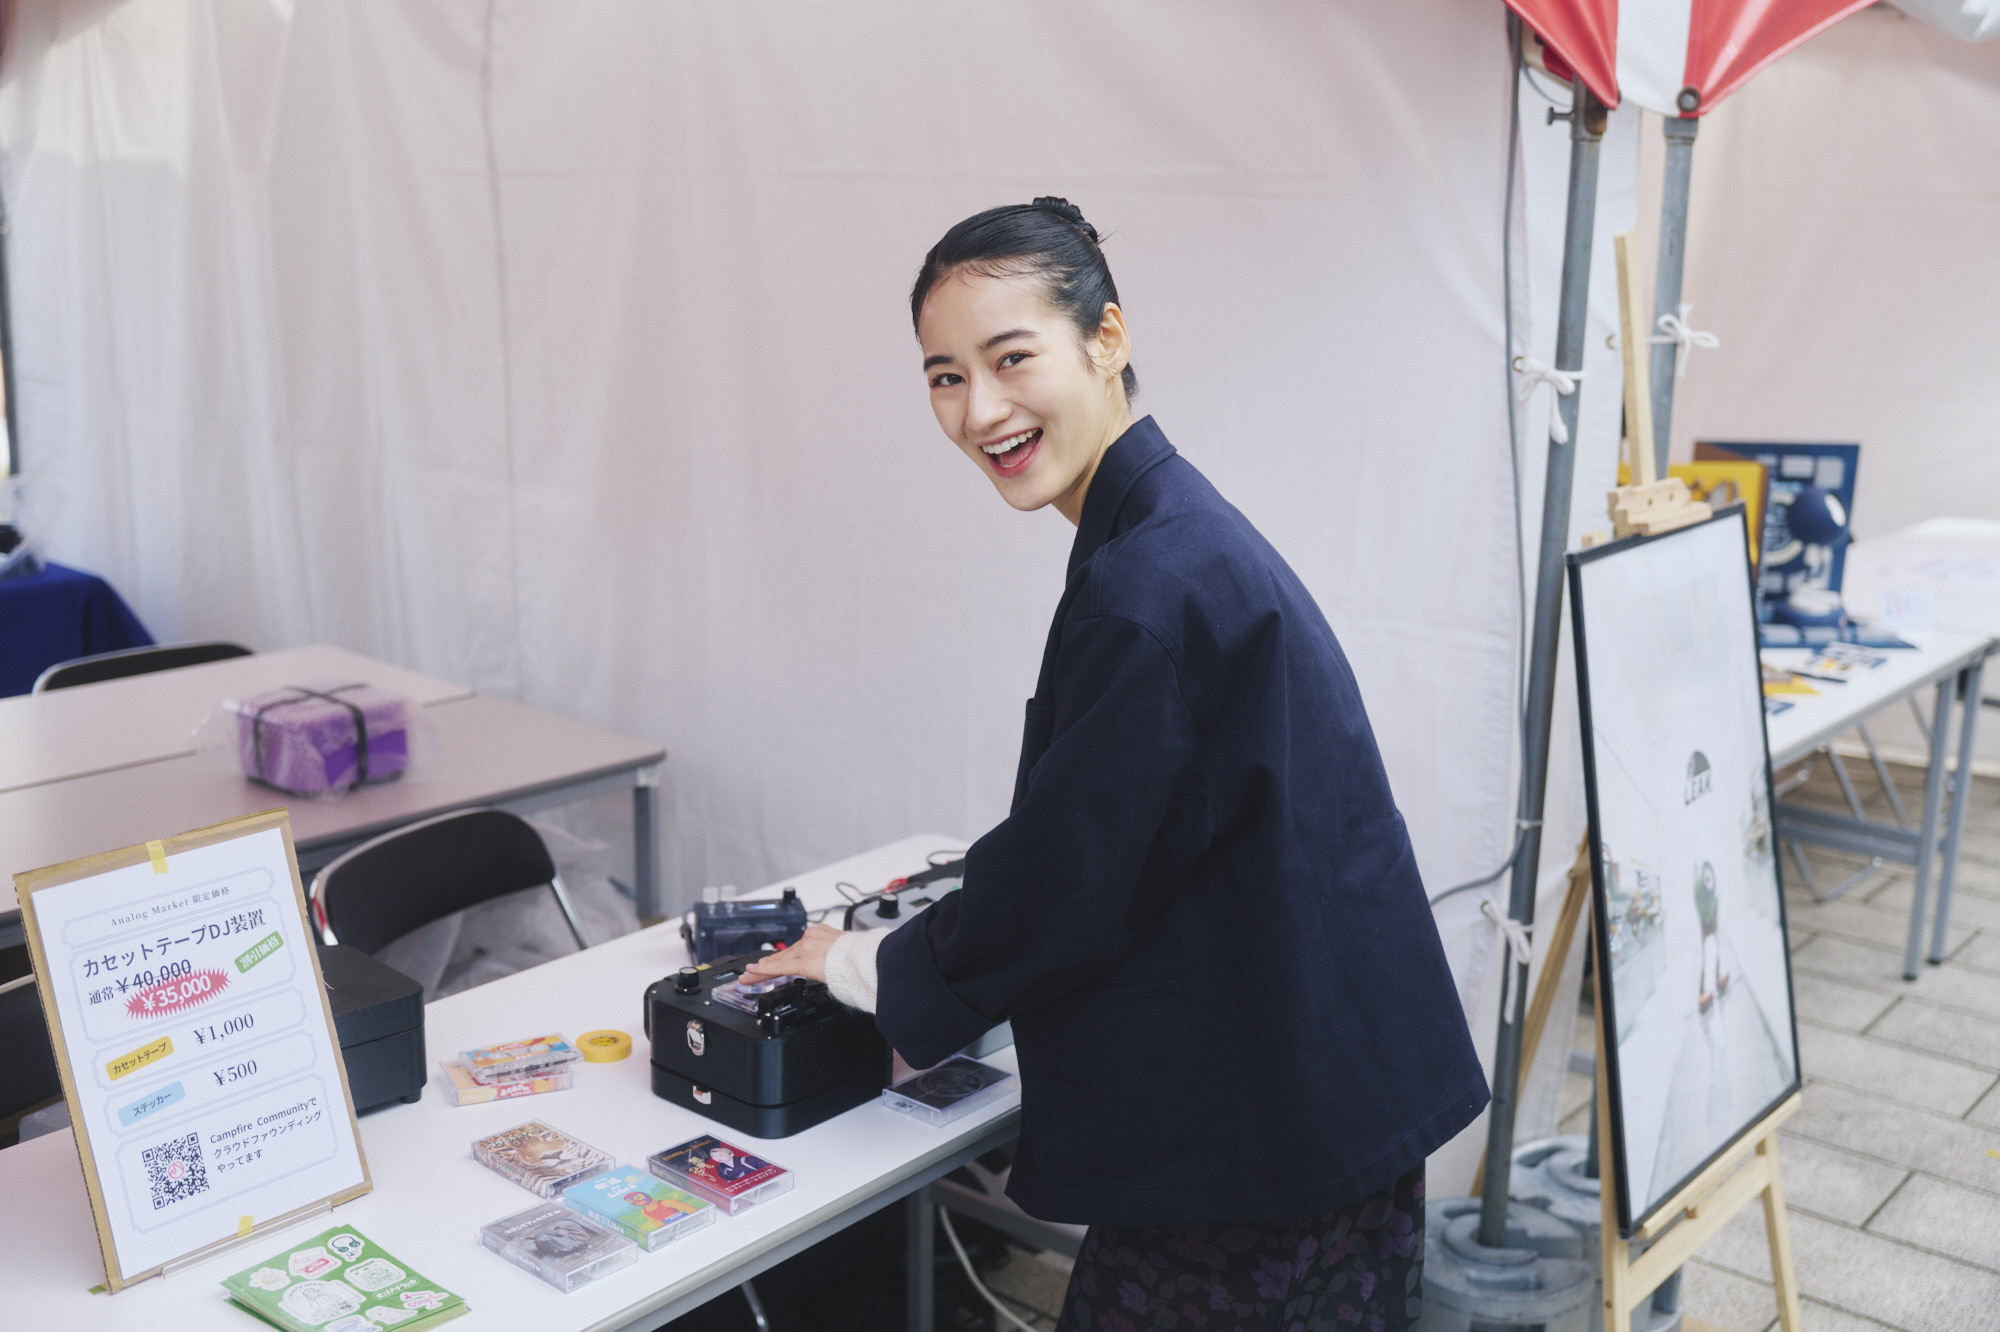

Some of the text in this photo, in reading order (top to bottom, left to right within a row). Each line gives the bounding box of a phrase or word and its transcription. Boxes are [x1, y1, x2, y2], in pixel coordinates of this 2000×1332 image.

[110, 886, 230, 927] Analog Market 限定価格
[83, 908, 266, 978] カセットテープDJ装置
[239, 934, 280, 969] 割引価格
[89, 986, 114, 1005] 通常
[193, 1013, 254, 1045] ¥1,000
[113, 1042, 167, 1075] カセットテープ
[213, 1059, 258, 1087] ¥500
[132, 1093, 172, 1117] ステッカー
[210, 1097, 317, 1144] Campfire Communityで
[214, 1110, 322, 1159] クラウドファウンディング
[217, 1149, 264, 1173] やってます
